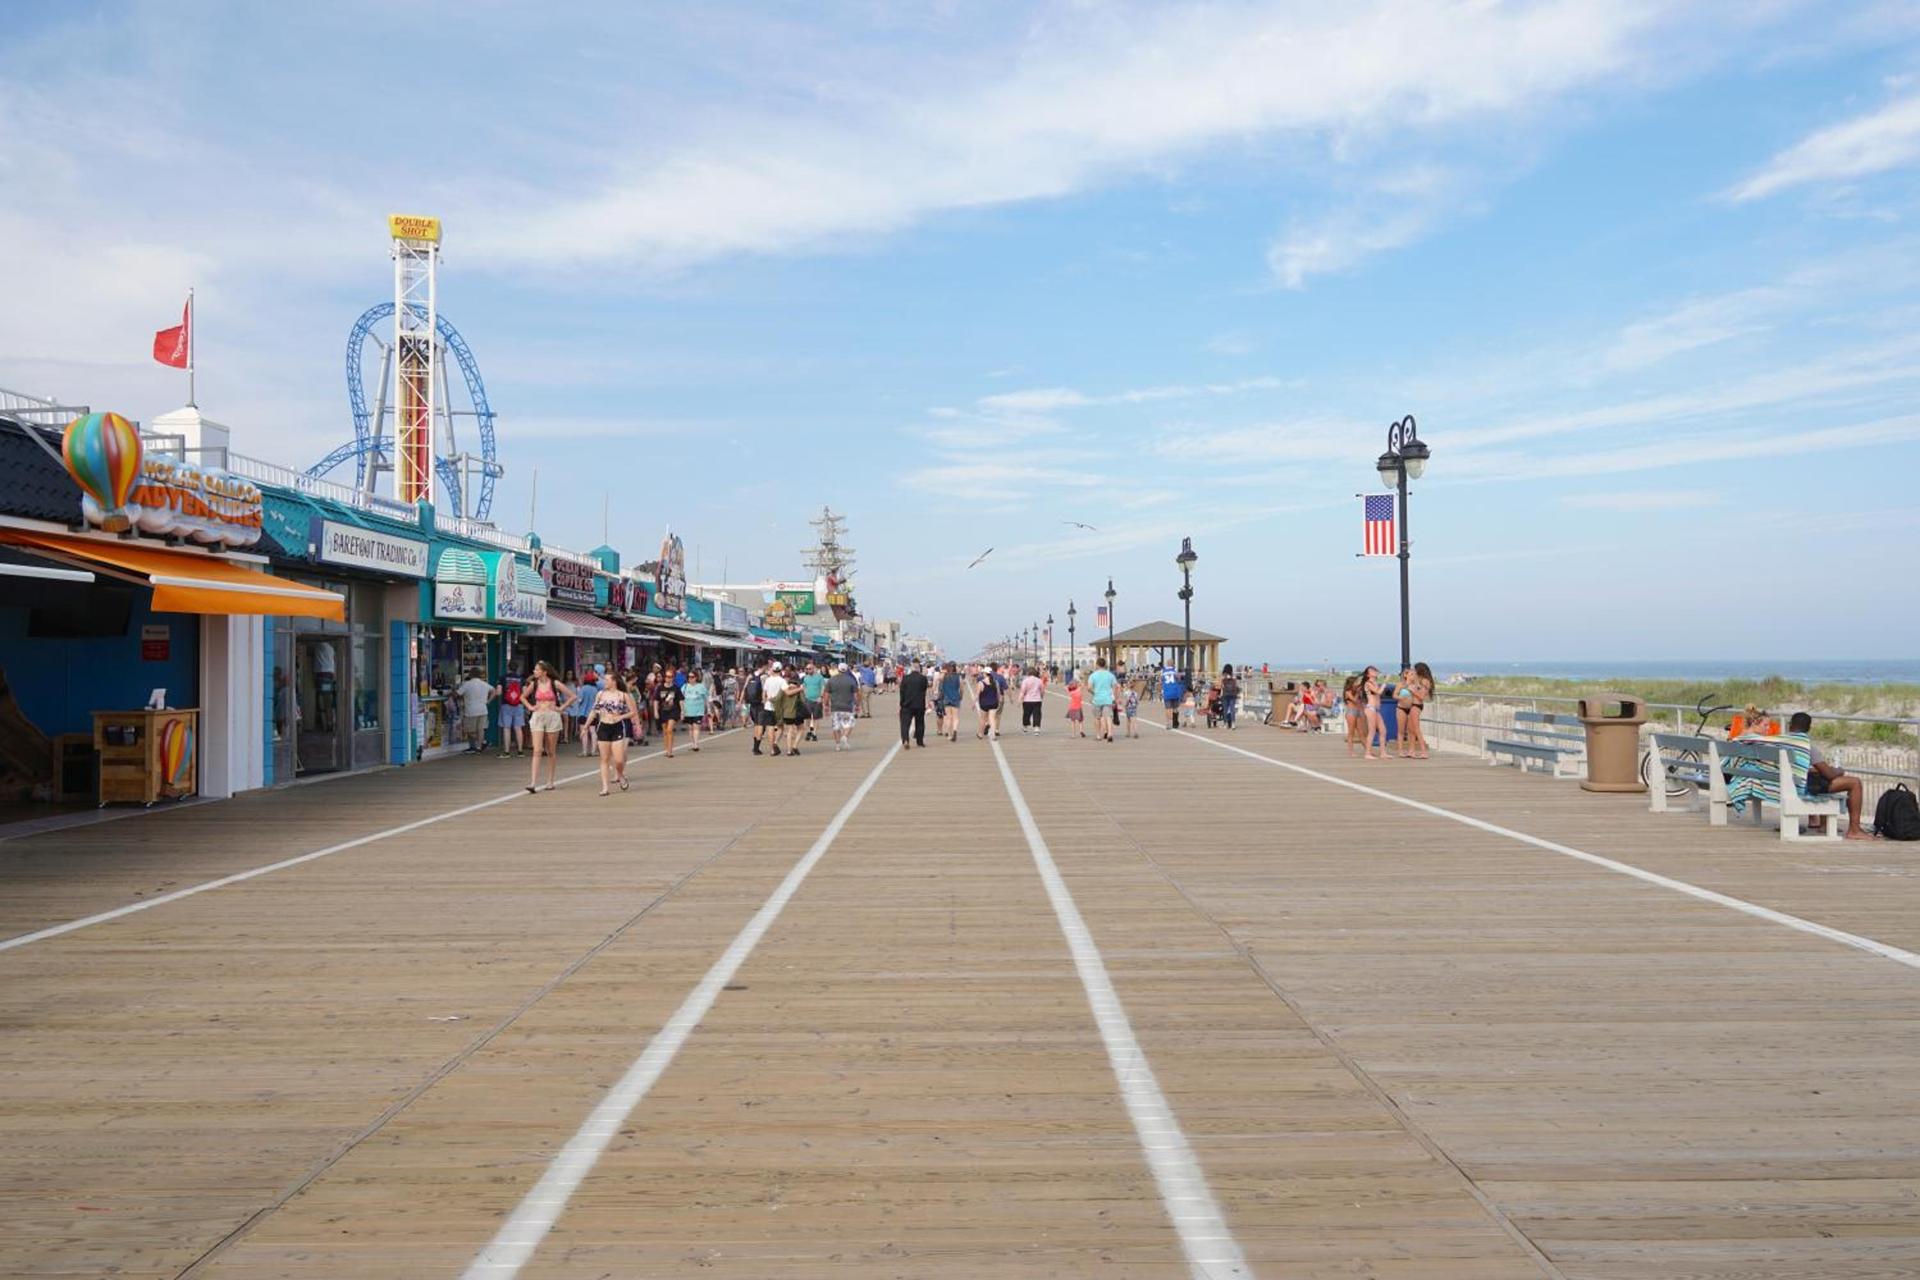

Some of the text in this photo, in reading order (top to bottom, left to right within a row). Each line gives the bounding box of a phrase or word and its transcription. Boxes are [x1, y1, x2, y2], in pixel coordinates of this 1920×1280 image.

[394, 217, 432, 227] DOUBLE
[400, 227, 426, 236] SHOT
[333, 532, 376, 559] BAREFOOT
[376, 541, 408, 565] TRADING
[556, 559, 579, 575] OCEAN
